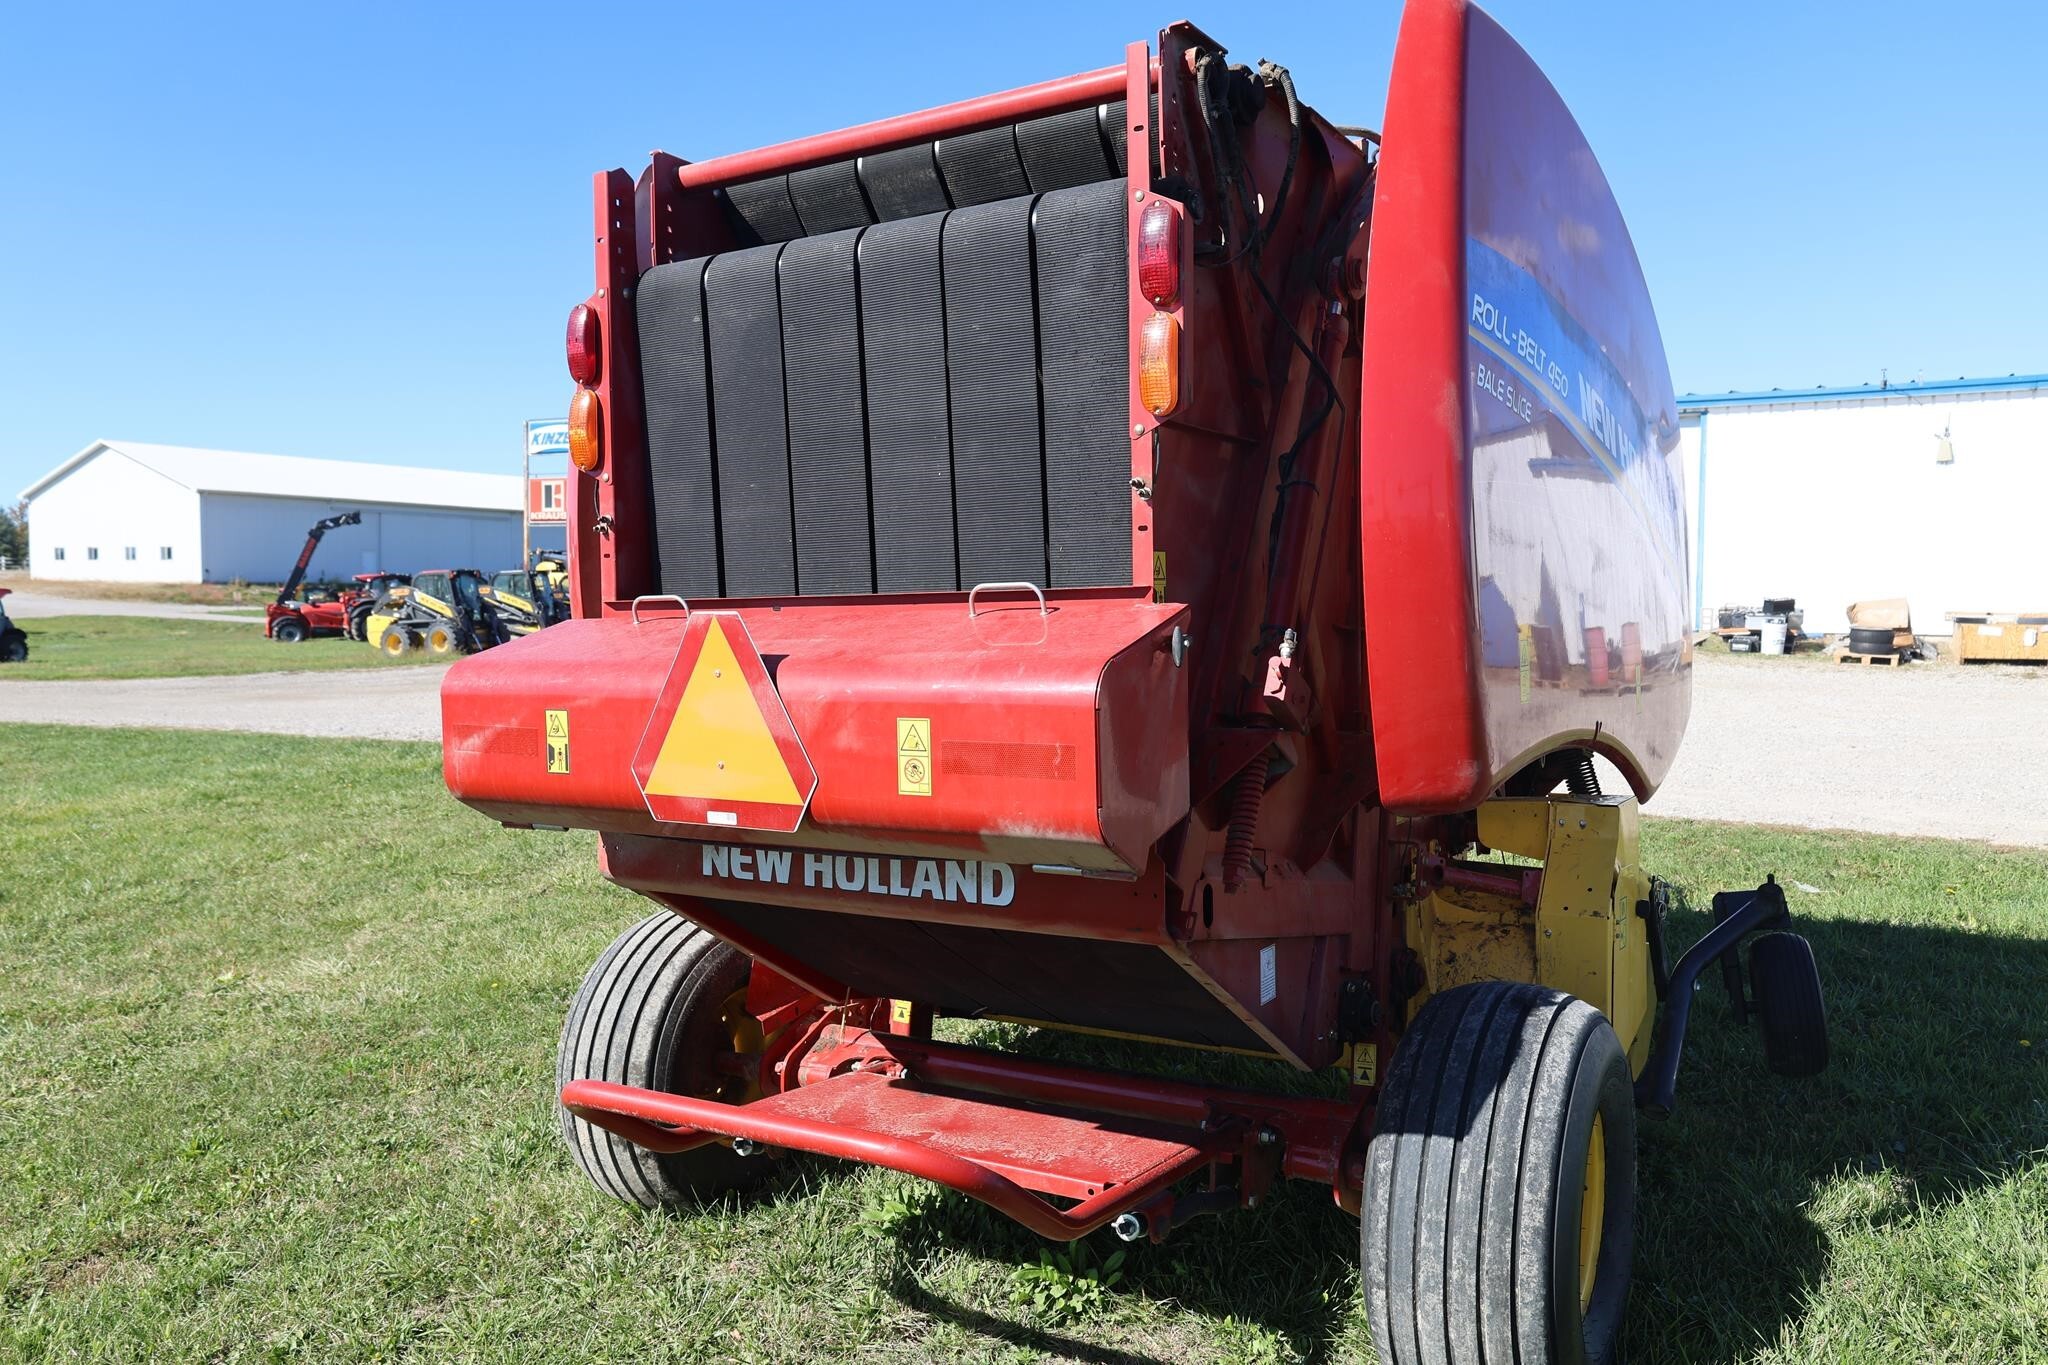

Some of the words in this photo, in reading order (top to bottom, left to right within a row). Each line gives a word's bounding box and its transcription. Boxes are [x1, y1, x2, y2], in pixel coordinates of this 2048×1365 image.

[1472, 294, 1546, 373] ROLL-BELT
[1548, 361, 1569, 397] 450
[1477, 363, 1505, 401] BALE
[1506, 386, 1532, 423] SLICE
[1578, 370, 1617, 458] NEW
[702, 843, 792, 884] NEW
[804, 853, 1015, 907] HOLLAND
